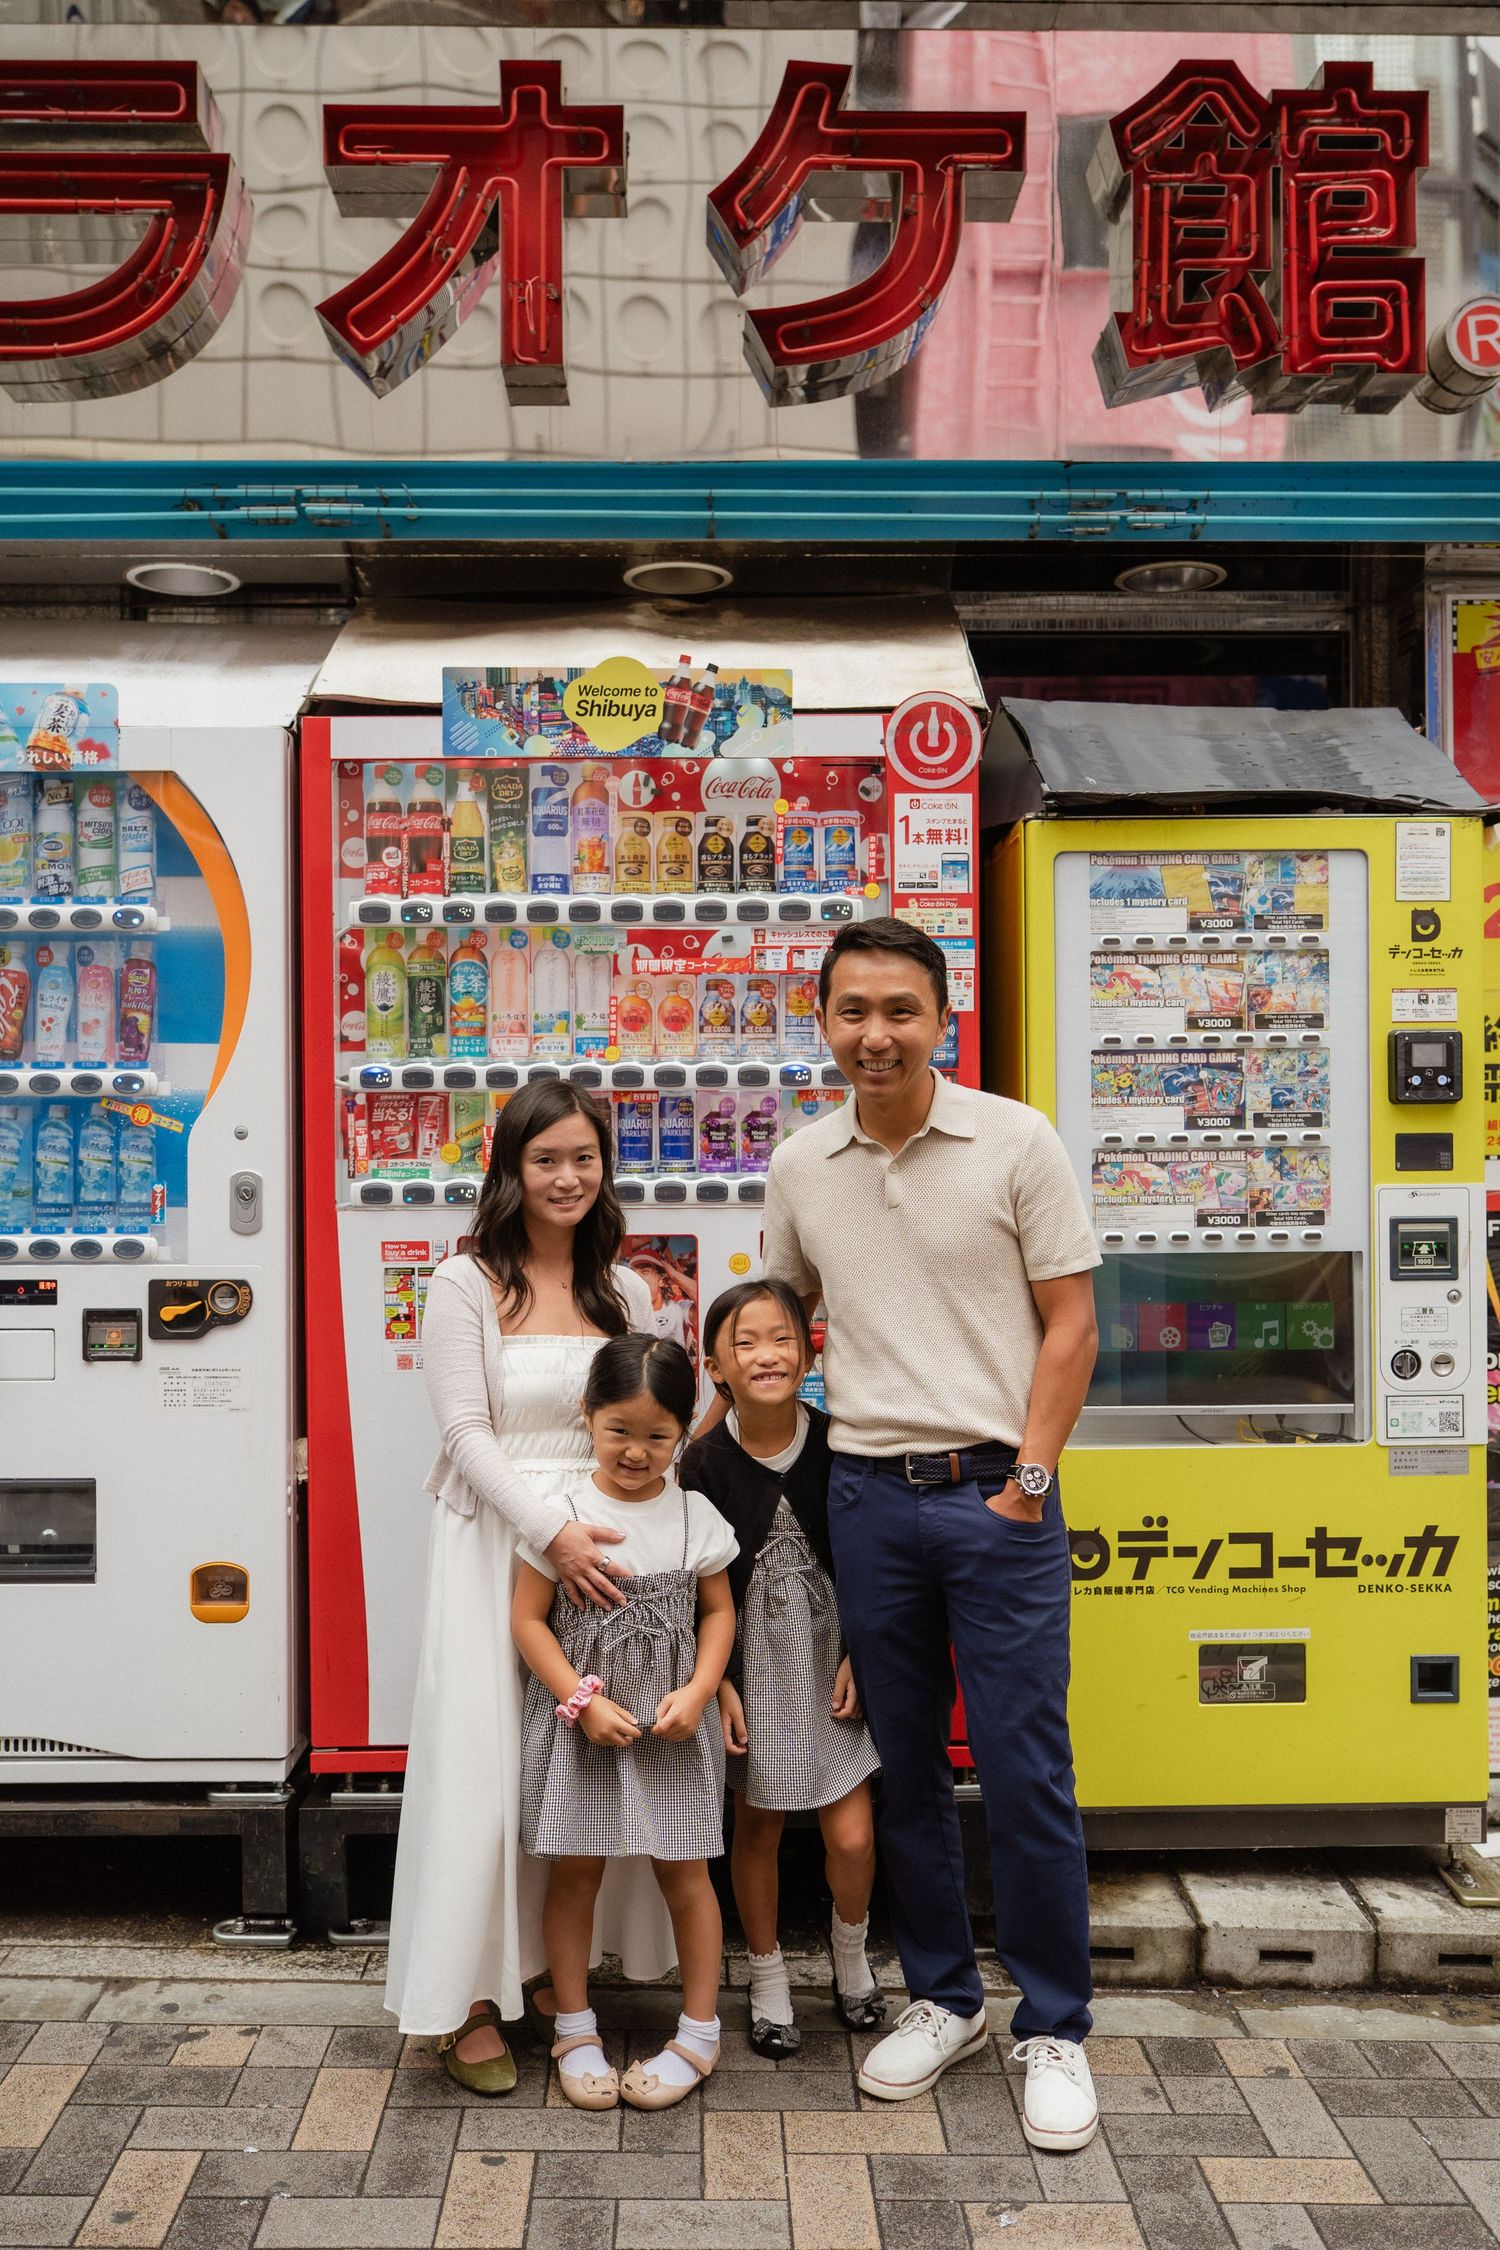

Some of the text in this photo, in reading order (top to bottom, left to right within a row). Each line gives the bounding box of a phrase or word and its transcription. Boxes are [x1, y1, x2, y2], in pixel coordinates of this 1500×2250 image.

[577, 684, 658, 698] Welcome to
[575, 700, 658, 721] Shibuya
[16, 751, 105, 765] うれしい価格。
[918, 766, 935, 774] Coke
[491, 783, 524, 791] CANADA
[705, 777, 776, 800] Coca-Cola
[532, 805, 568, 816] AQUARIUS
[898, 814, 968, 846] 1本無料!
[1139, 854, 1182, 866] TRADING
[1183, 854, 1210, 866] CARD
[1211, 854, 1239, 866] GAME
[1126, 898, 1188, 908] 1 mystery card
[1200, 918, 1234, 928] ¥3000
[1388, 944, 1464, 959] デンコーセッカ
[1137, 953, 1180, 965] TRADING
[1180, 953, 1208, 965] CARD
[1209, 953, 1238, 965] GAME
[635, 958, 717, 972] 期間限定コーナー
[450, 972, 487, 993] 麦茶
[1130, 999, 1163, 1008] mystery
[1198, 1018, 1232, 1028] ¥3000
[1136, 1052, 1179, 1065] TRADING
[1180, 1052, 1208, 1065] CARD
[1208, 1052, 1237, 1065] GAME
[1123, 1096, 1185, 1105] 1 mystery card
[371, 1107, 413, 1122] 当たる!
[1197, 1118, 1231, 1127] ¥3000
[1146, 1150, 1190, 1163] TRADING
[1190, 1150, 1218, 1163] CARD
[1218, 1150, 1247, 1163] GAME
[1138, 1195, 1175, 1204] mystery
[1207, 1216, 1241, 1225] ¥3000
[385, 1249, 400, 1257] buy
[407, 1248, 428, 1256] drink
[1117, 1515, 1461, 1581] デンコーセッカ
[1166, 1584, 1307, 1595] TCG Vending Machines Shop
[1357, 1583, 1453, 1593] DENKO-SEKKA
